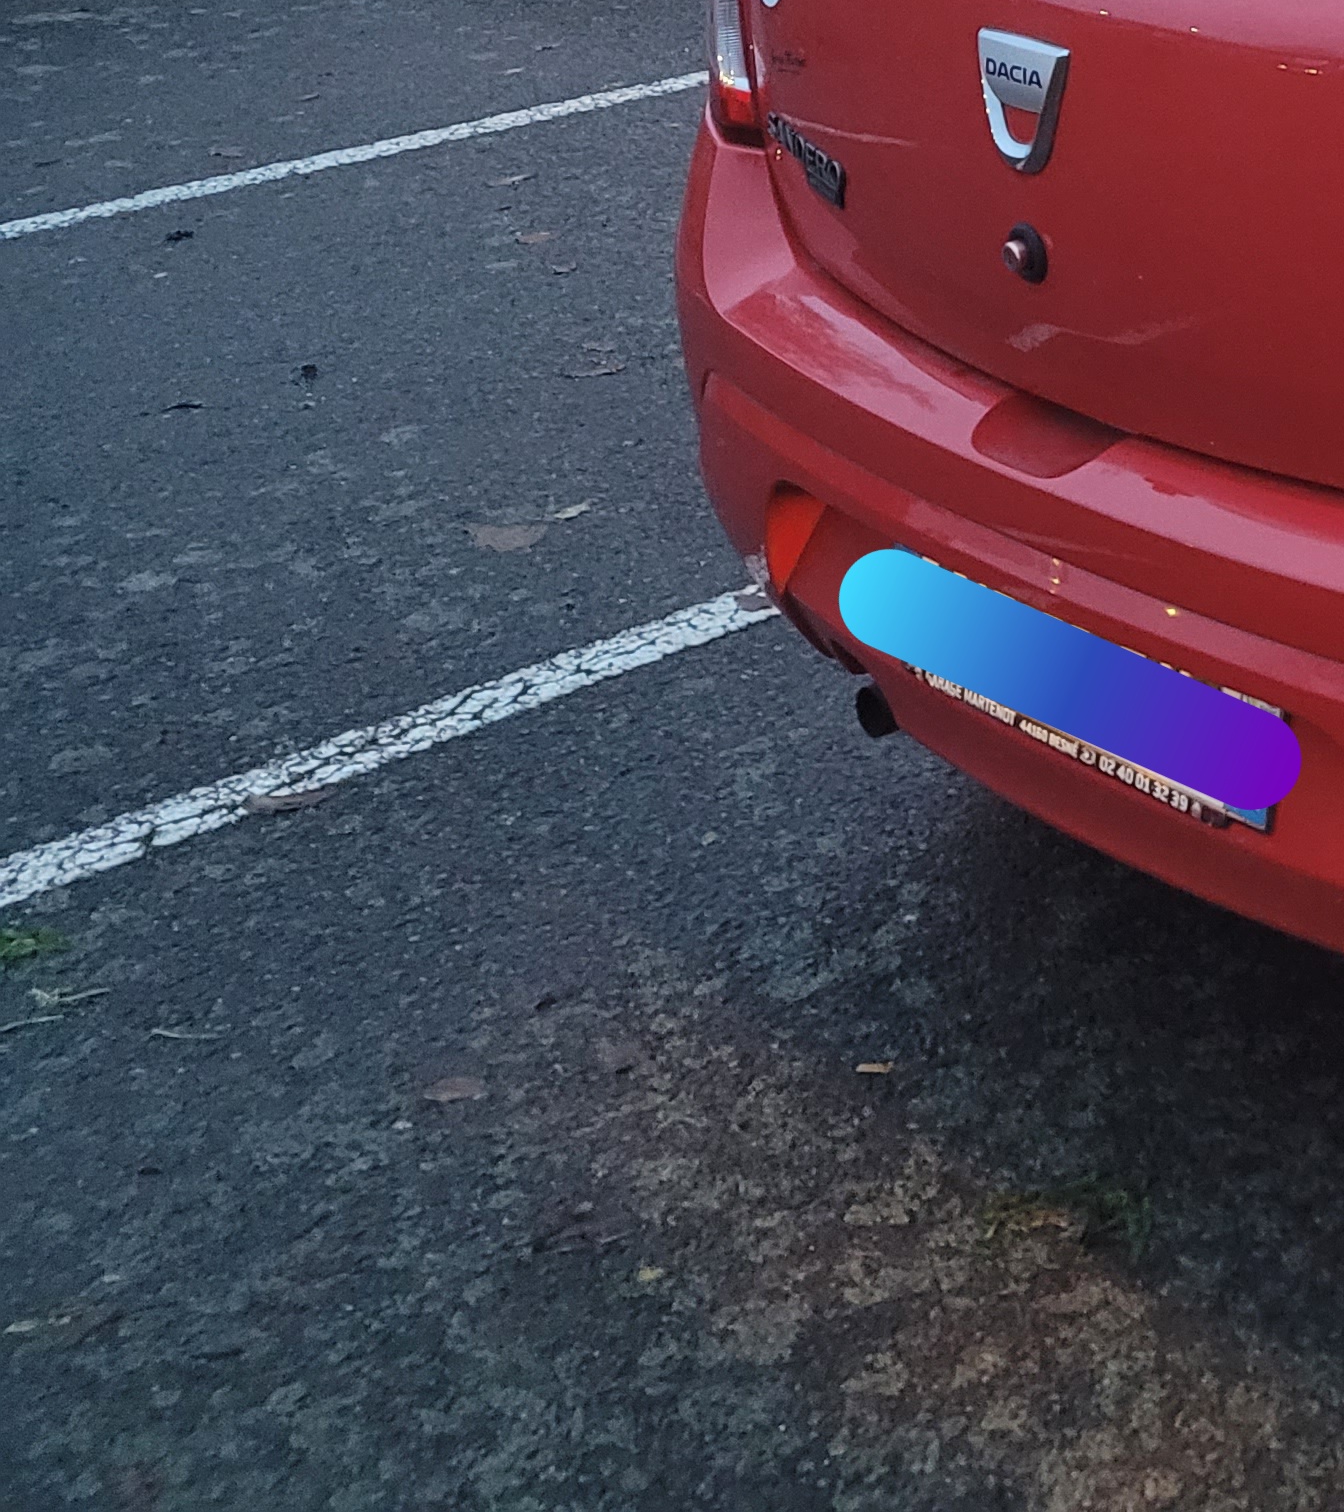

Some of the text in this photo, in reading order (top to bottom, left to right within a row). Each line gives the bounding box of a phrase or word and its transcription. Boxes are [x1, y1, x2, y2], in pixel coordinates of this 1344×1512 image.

[984, 56, 1043, 90] DACIA
[1099, 755, 1117, 776] 02
[1116, 765, 1133, 785] 40
[1134, 774, 1150, 795] 01
[1151, 781, 1169, 804] 32
[1170, 790, 1189, 814] 39
